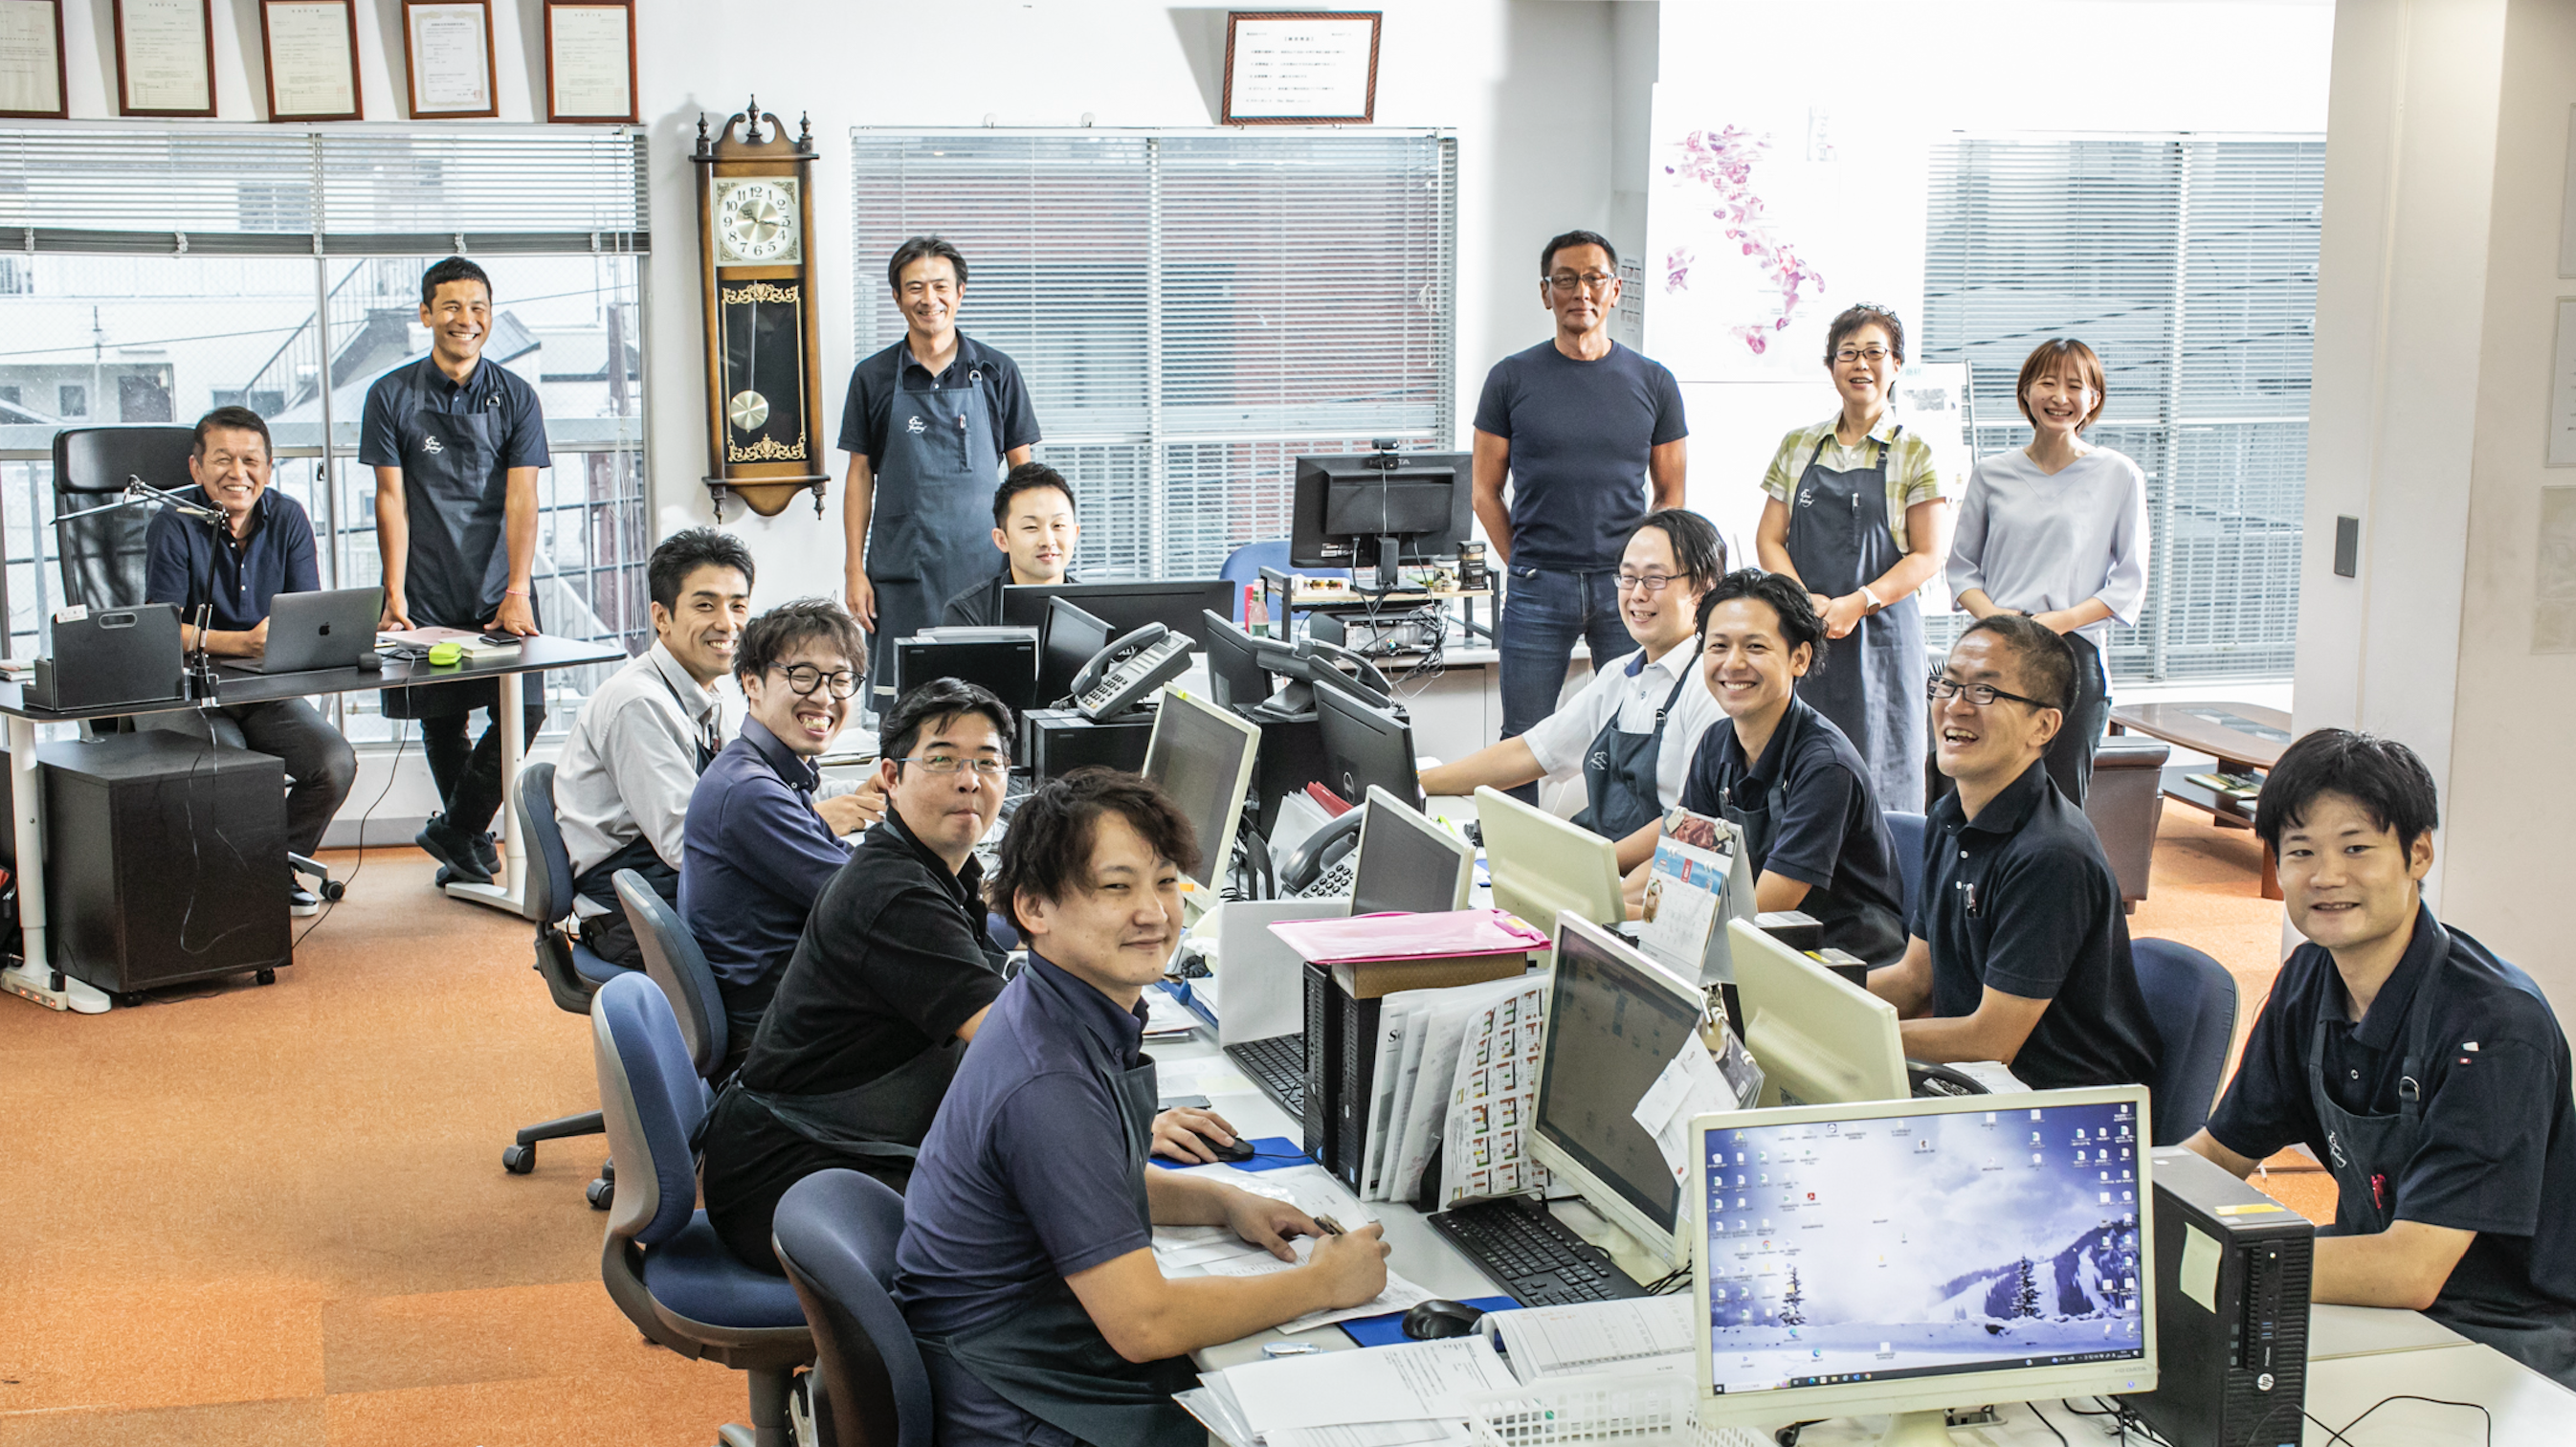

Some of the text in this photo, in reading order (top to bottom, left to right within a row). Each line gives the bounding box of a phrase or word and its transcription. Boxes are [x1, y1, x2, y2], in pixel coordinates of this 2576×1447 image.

[738, 189, 746, 201] 11
[750, 187, 763, 197] 12
[726, 201, 738, 211] 10
[777, 199, 786, 210] 2
[723, 217, 732, 227] 9
[782, 215, 790, 227] 3
[728, 231, 737, 242] 8
[778, 230, 787, 240] 4
[740, 242, 748, 253] 7
[754, 245, 763, 256] 6
[768, 241, 776, 252] 5
[2257, 1375, 2275, 1388] hp
